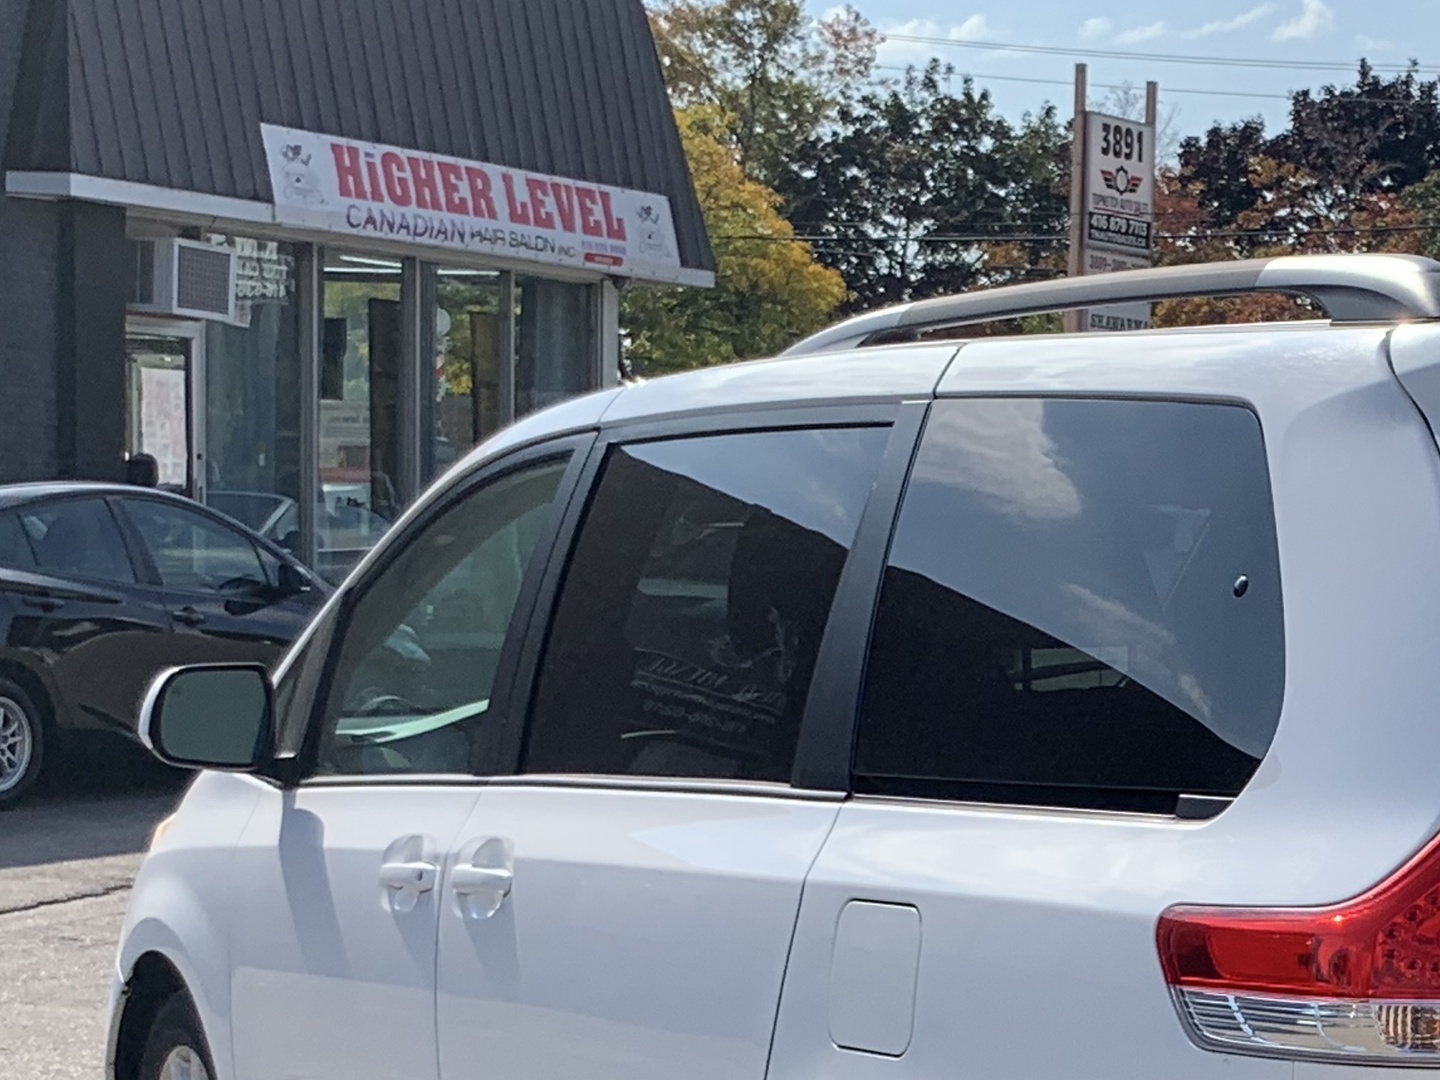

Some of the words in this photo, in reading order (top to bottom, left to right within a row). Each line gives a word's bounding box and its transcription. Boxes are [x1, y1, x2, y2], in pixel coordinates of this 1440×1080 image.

[1101, 122, 1144, 164] 3891
[346, 204, 466, 244] CANADIAN
[508, 232, 556, 254] SALON
[502, 173, 627, 241] LEVEL
[1091, 214, 1108, 230] 416
[1109, 216, 1128, 233] 879
